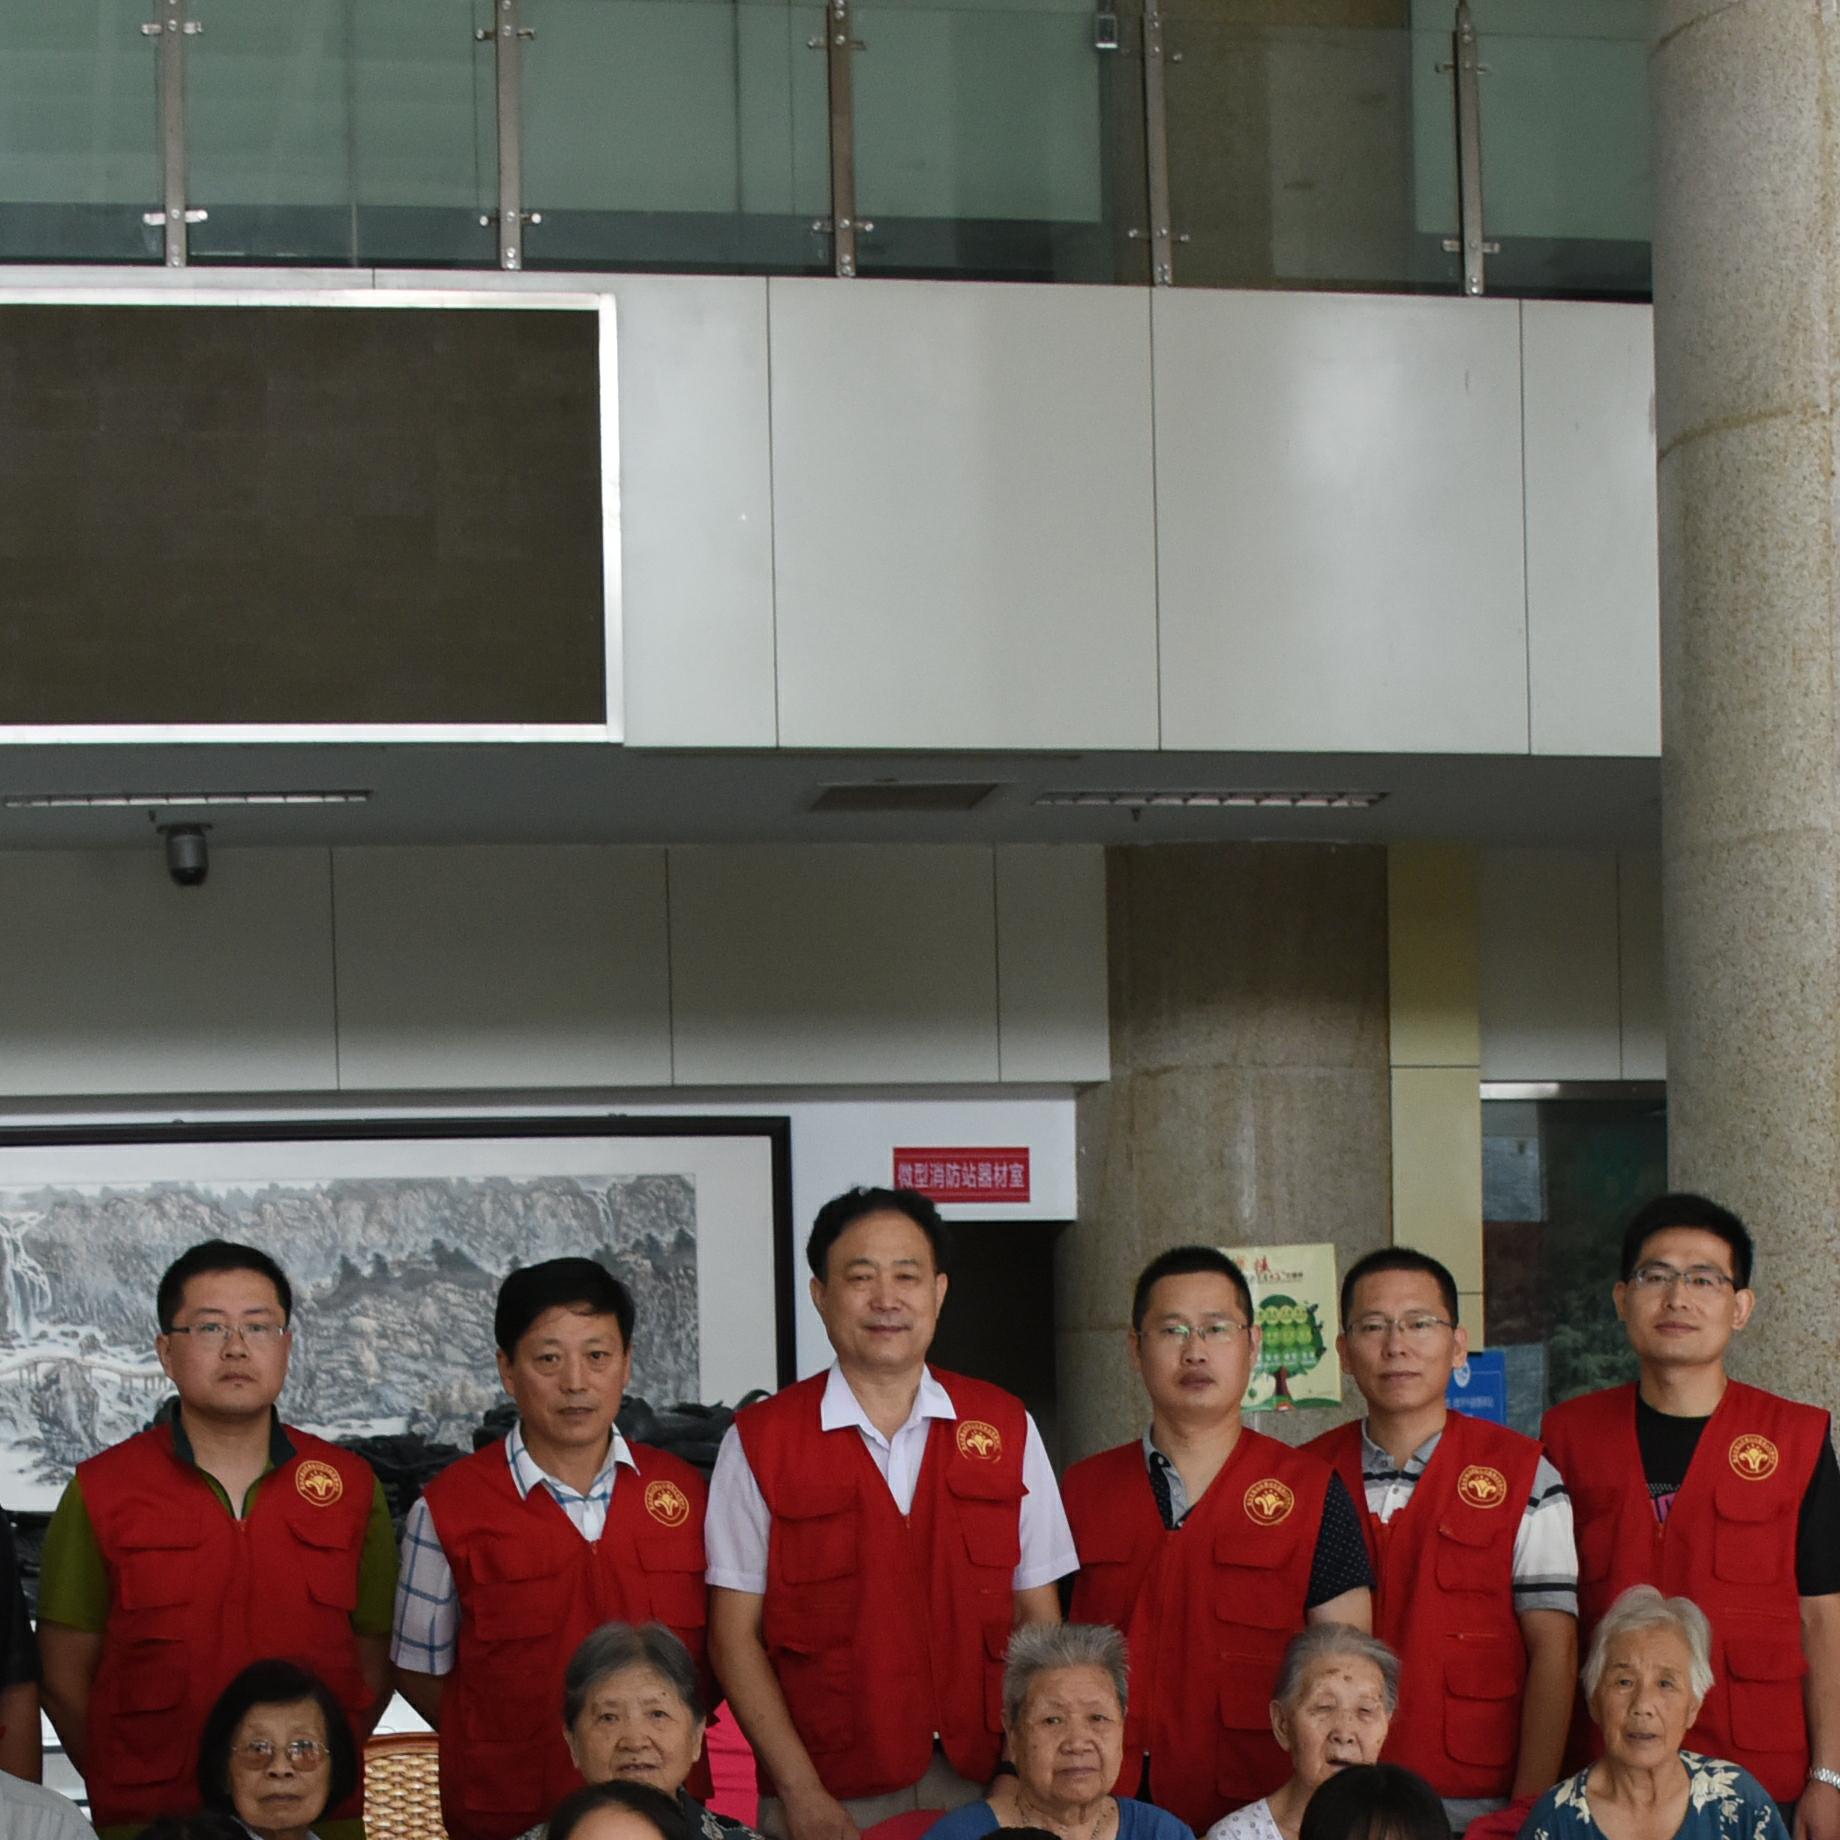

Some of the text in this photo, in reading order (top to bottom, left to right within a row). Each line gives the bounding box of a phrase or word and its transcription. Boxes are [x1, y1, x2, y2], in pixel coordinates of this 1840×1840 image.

[897, 1161, 1025, 1189] 微型消防站器材室
